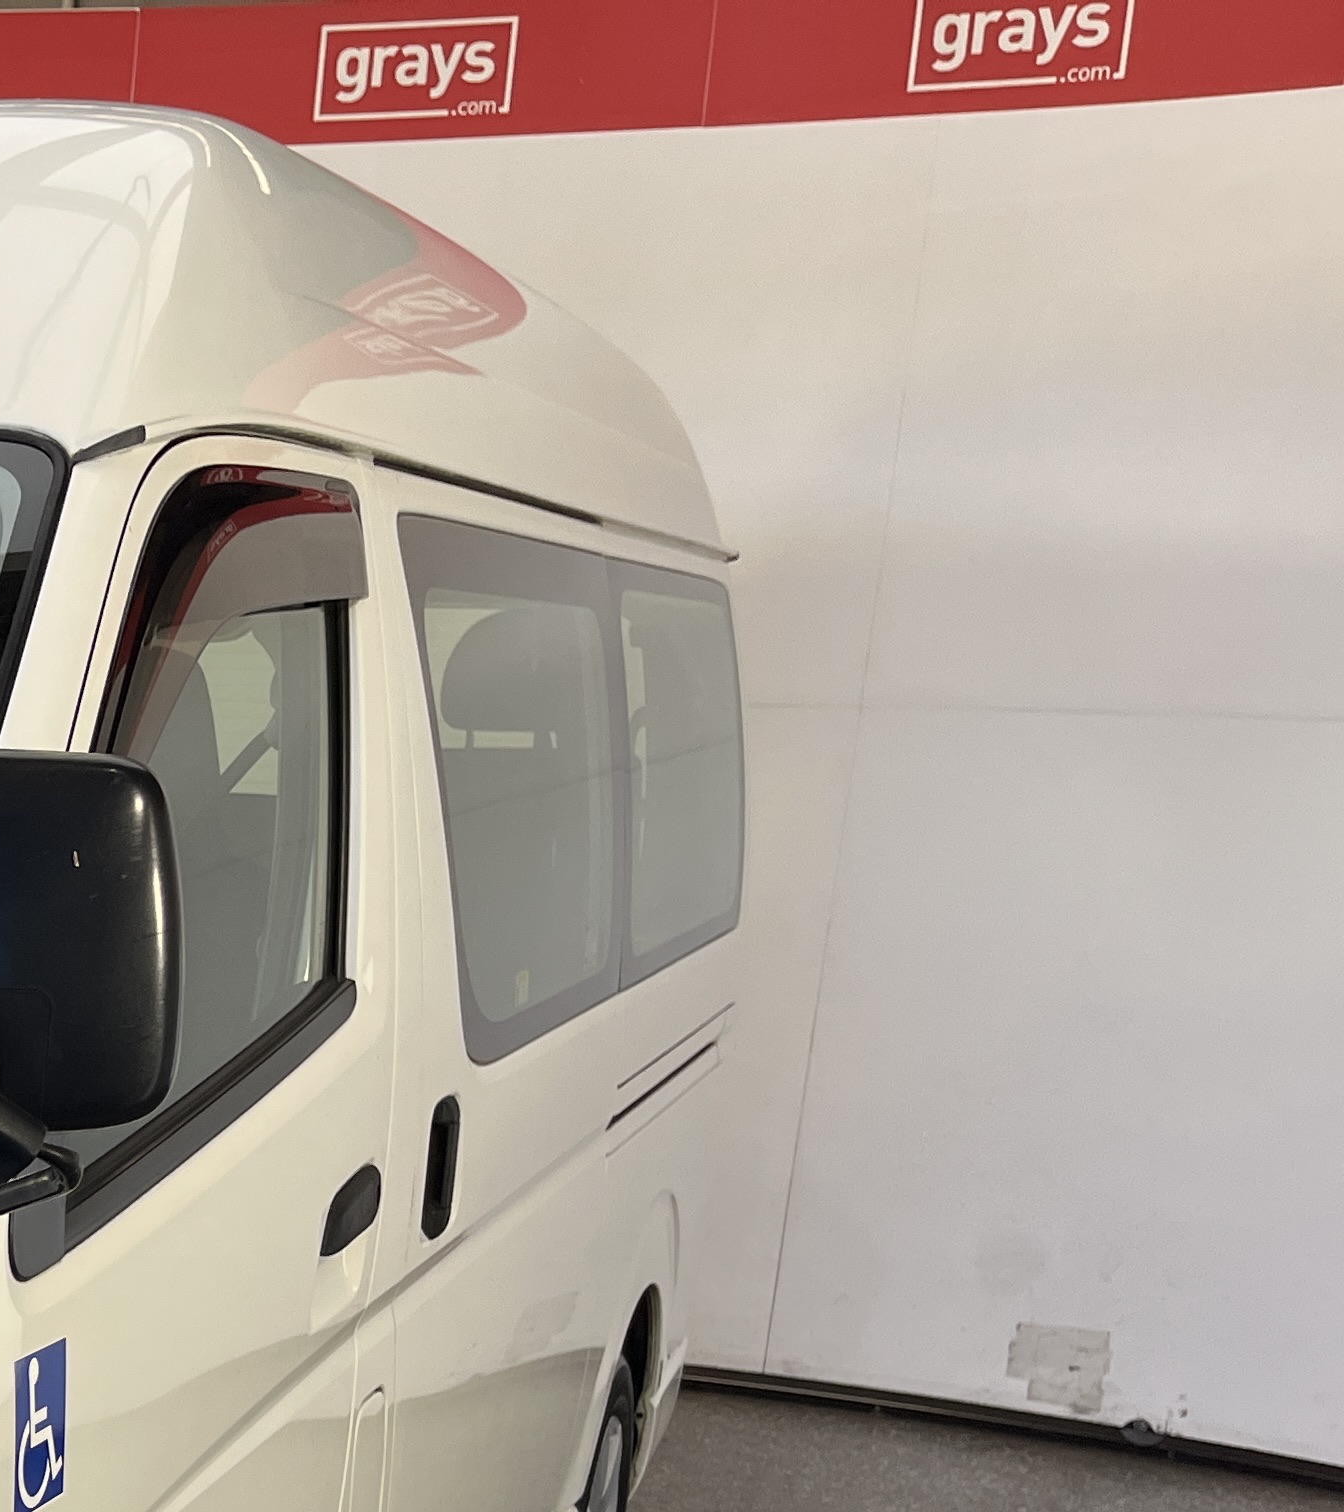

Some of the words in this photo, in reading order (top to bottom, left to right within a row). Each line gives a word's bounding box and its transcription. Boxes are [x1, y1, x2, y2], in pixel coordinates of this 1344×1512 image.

[932, 2, 1111, 72] grays
[335, 40, 496, 104] grays
[1060, 65, 1111, 83] .com
[450, 99, 497, 117] .com
